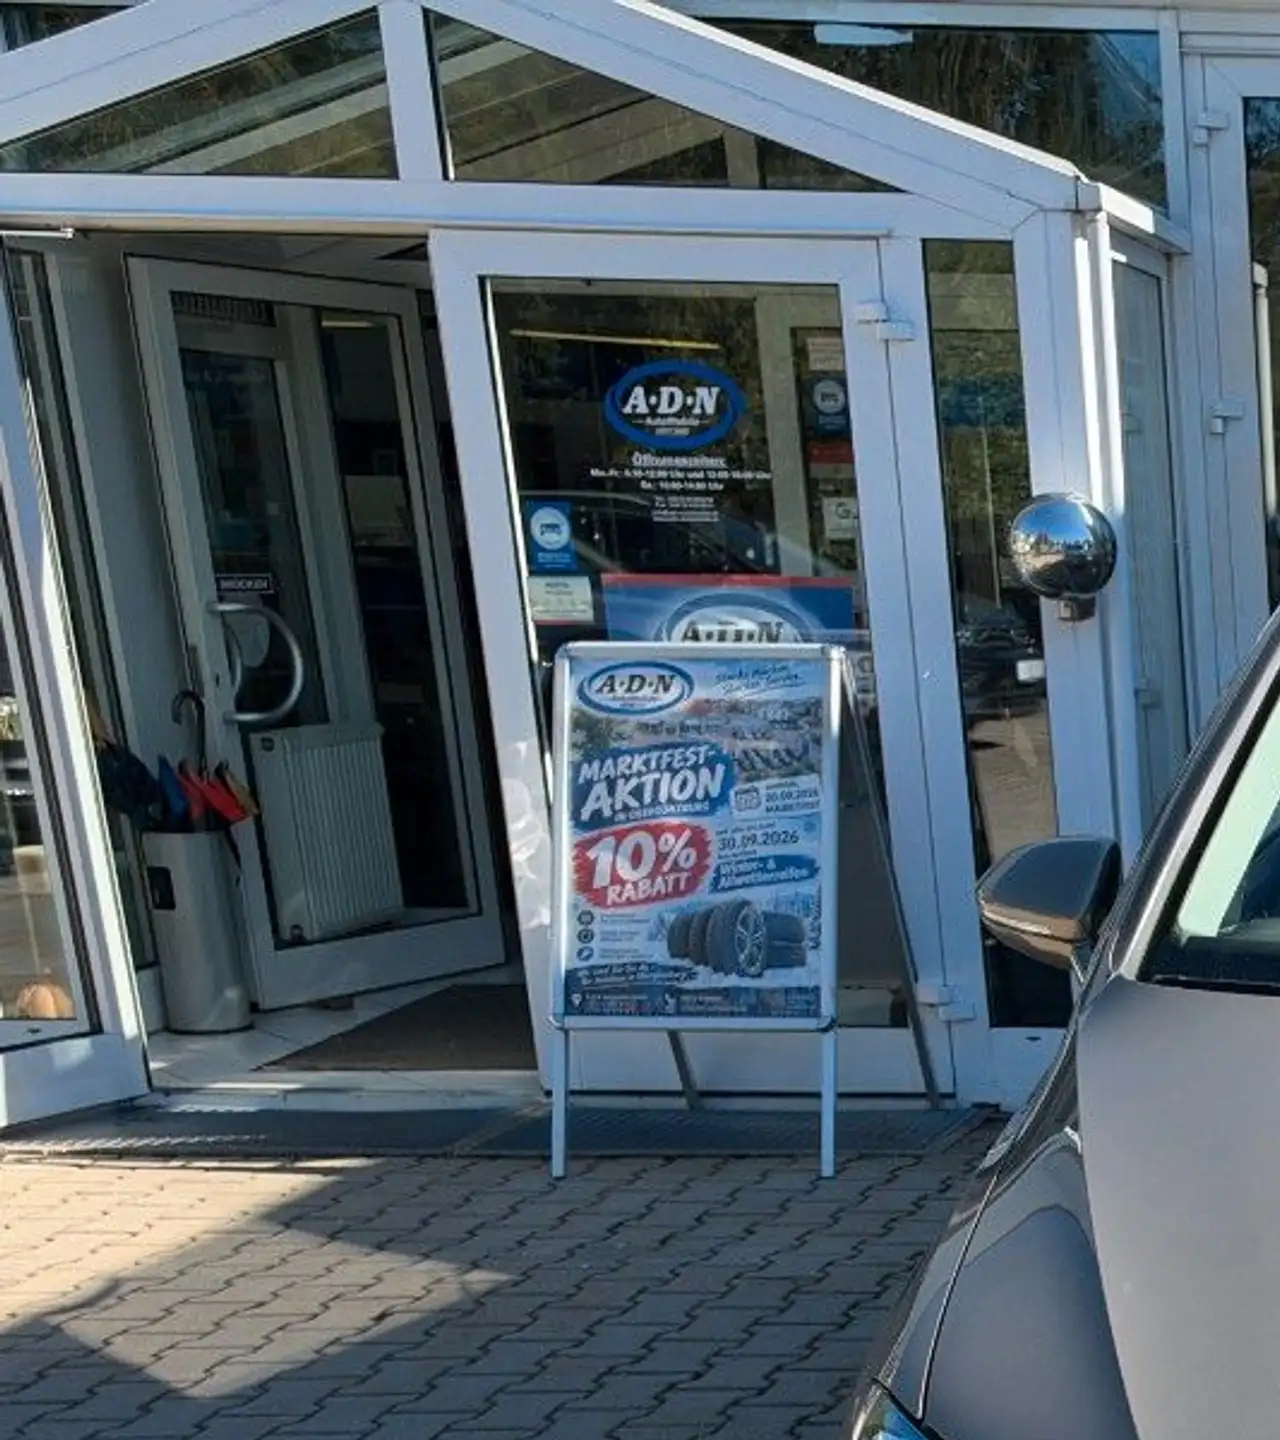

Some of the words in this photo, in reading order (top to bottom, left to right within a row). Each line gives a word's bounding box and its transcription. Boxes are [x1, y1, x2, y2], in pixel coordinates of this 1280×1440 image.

[578, 743, 716, 784] MARKTFEST-
[580, 763, 726, 821] AKTION
[586, 828, 698, 889] 10%
[606, 870, 693, 906] RABATT
